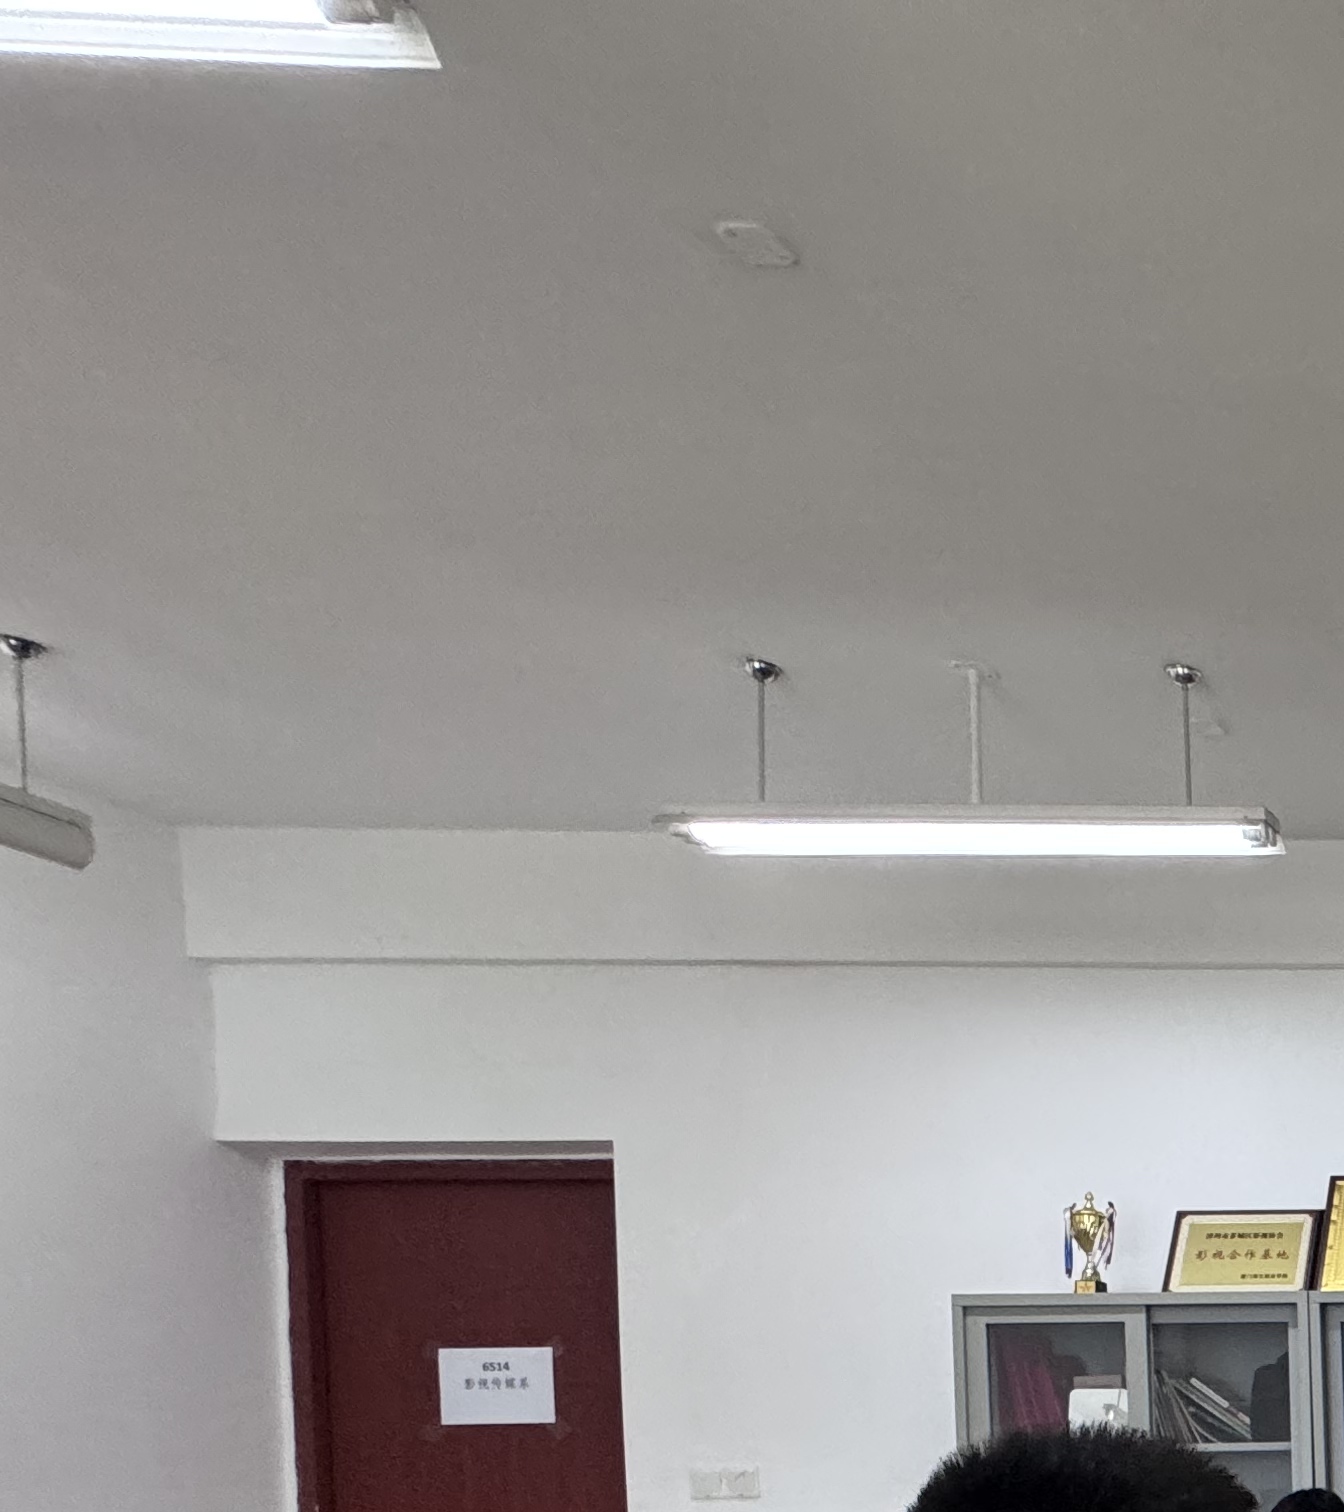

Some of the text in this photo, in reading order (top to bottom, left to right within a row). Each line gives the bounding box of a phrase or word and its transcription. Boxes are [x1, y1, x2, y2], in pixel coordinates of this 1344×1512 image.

[1195, 1248, 1290, 1262] 影视合作基地
